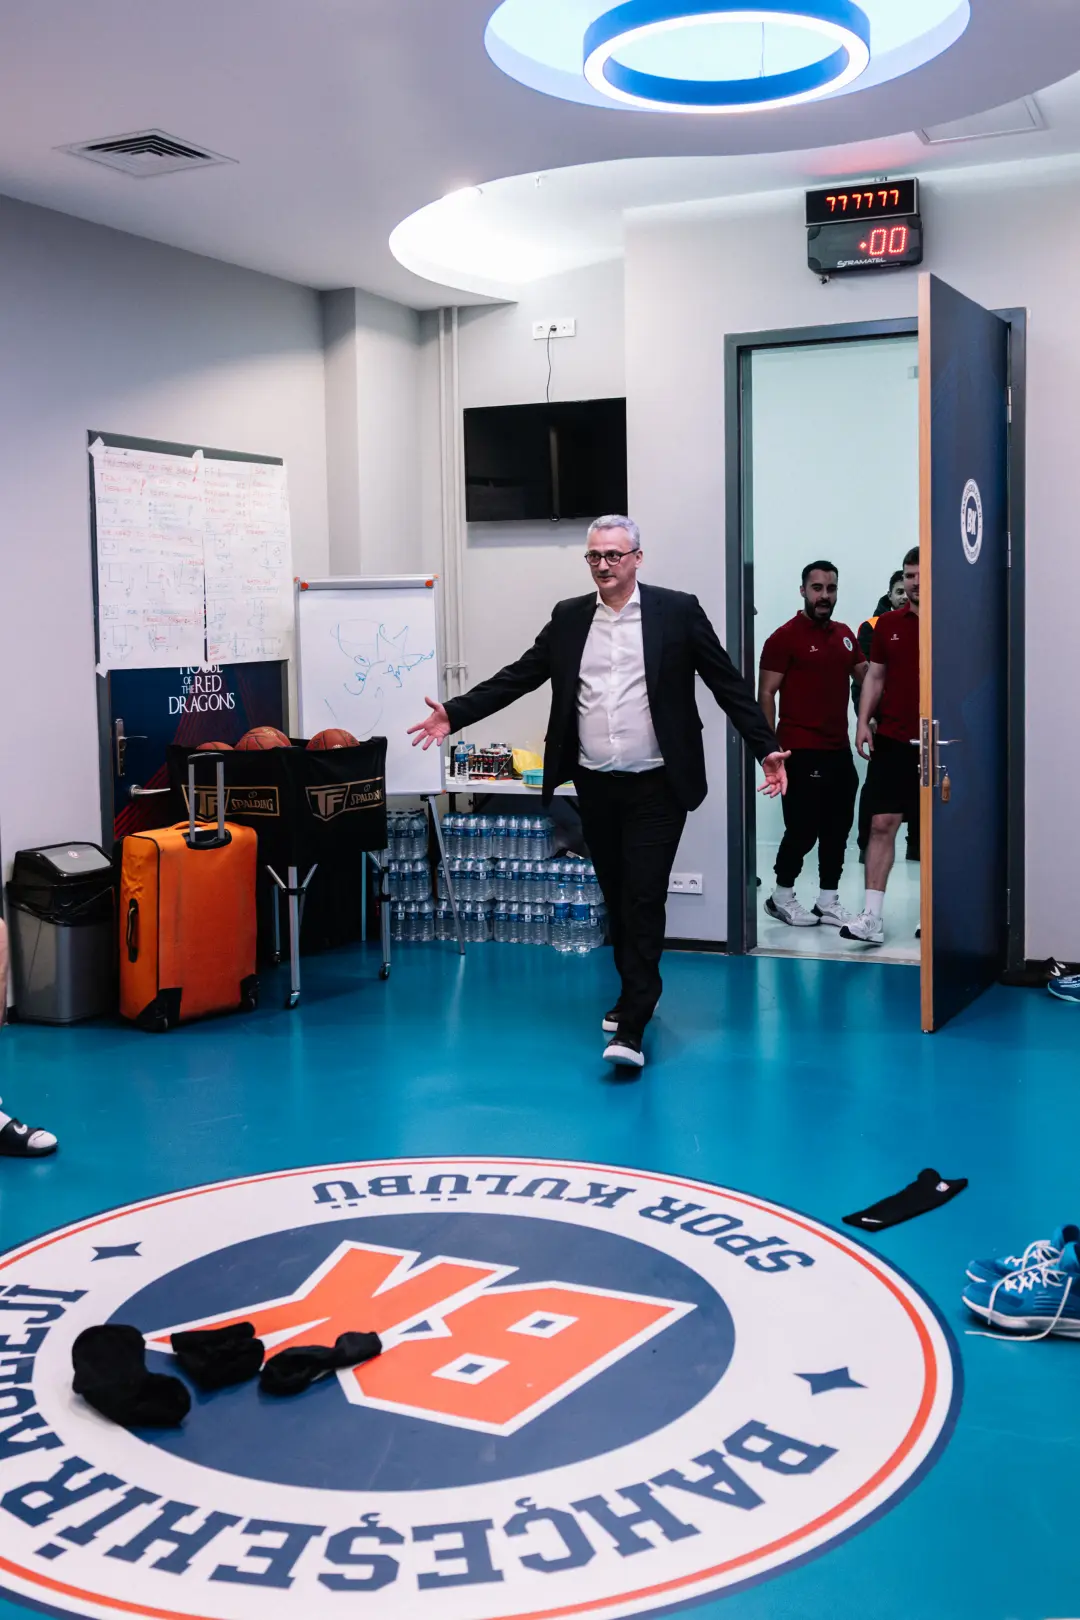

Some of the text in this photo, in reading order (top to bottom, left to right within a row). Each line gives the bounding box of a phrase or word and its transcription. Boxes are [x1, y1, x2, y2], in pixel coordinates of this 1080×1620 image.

[836, 257, 886, 269] STRAMATEL
[194, 675, 222, 693] RED
[168, 692, 236, 714] DRAGONS
[231, 798, 274, 812] SPALDING
[311, 787, 348, 817] TF
[313, 1173, 815, 1274] SPOR KULÜBÜ
[1, 1419, 839, 1592] BAHÇEŞEHİR
